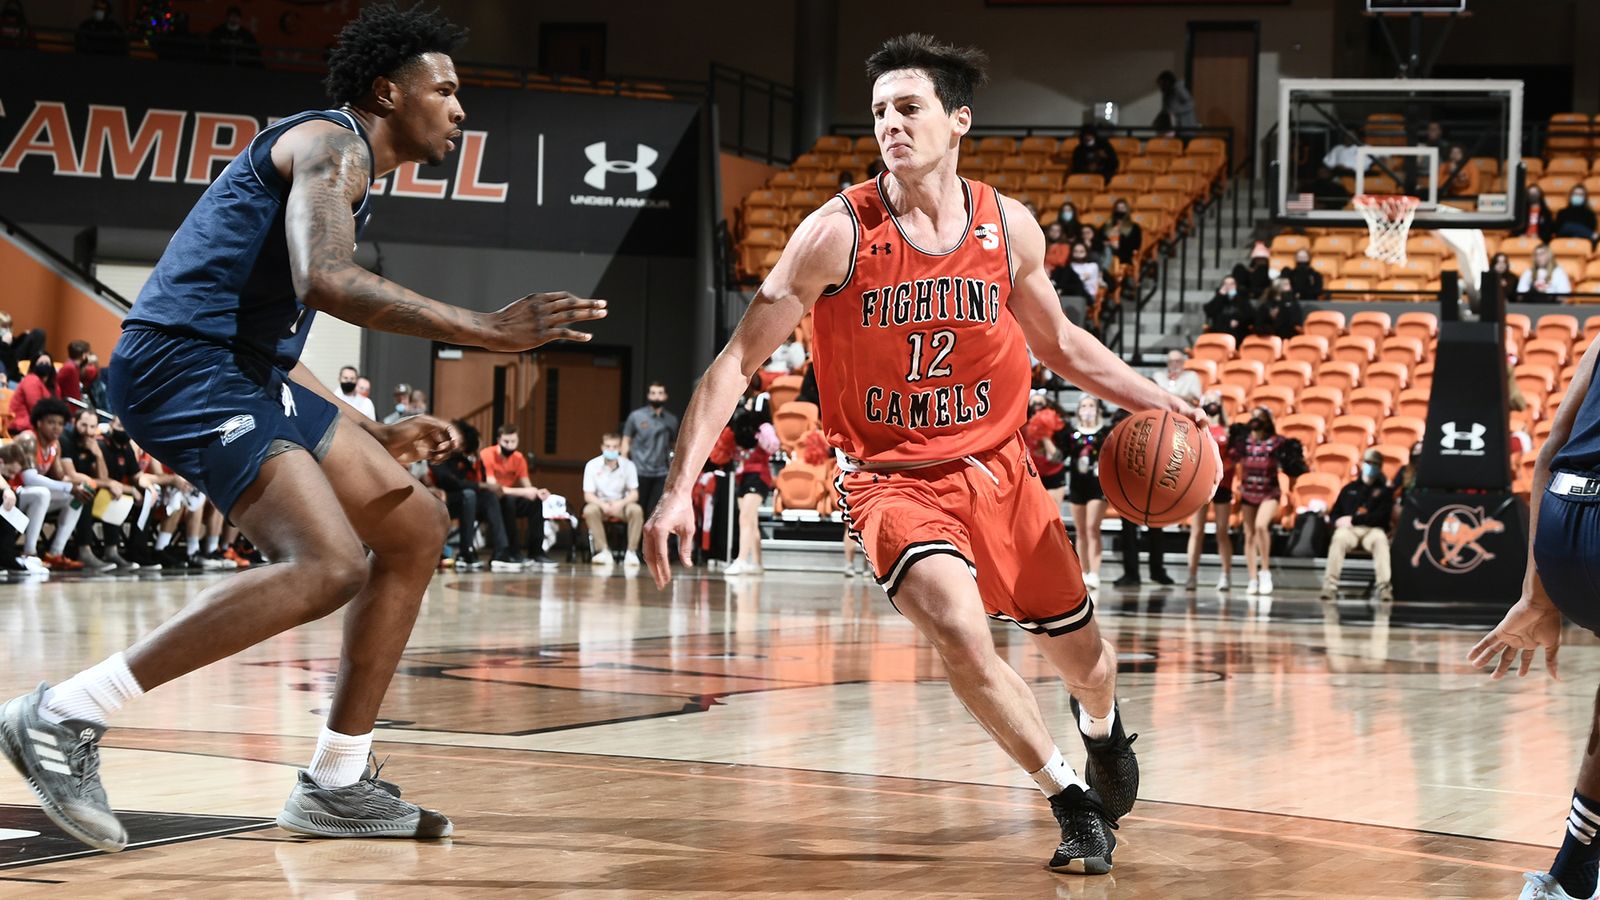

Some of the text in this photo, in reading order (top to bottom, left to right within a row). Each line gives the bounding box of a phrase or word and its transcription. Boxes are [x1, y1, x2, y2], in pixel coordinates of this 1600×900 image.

[0, 98, 509, 202] AMPLL
[570, 194, 614, 207] UNDER
[861, 276, 1000, 328] FIGHTING
[905, 330, 957, 383] 12
[865, 379, 992, 430] CAMELS
